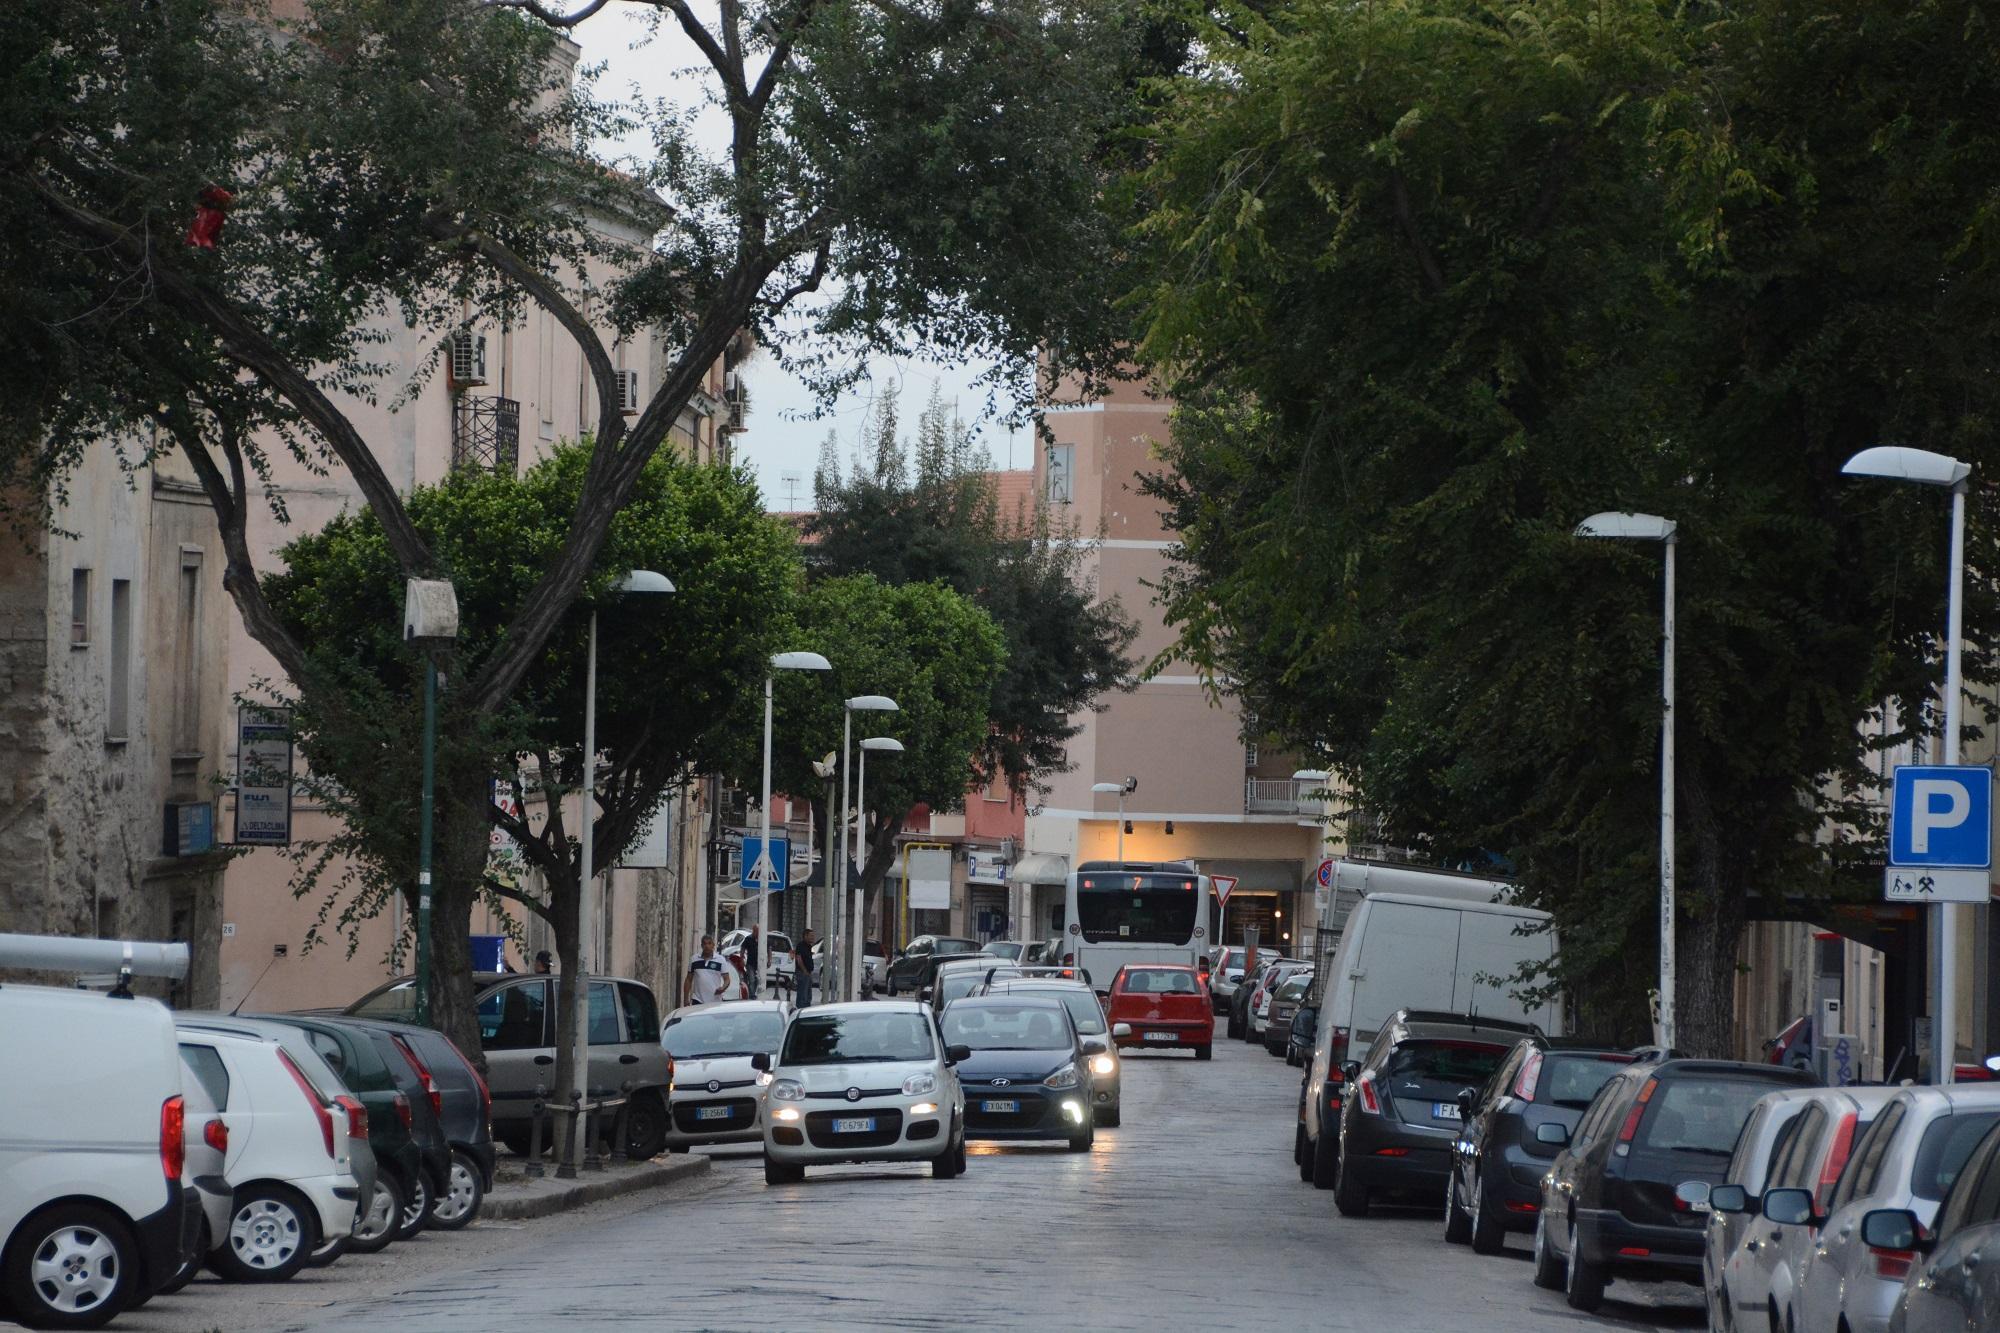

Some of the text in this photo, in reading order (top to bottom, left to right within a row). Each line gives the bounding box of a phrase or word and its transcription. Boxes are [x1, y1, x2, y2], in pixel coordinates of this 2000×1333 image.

[1911, 779, 1971, 854] P
[970, 858, 975, 875] P
[1133, 876, 1143, 891] 7
[223, 926, 233, 934] 26
